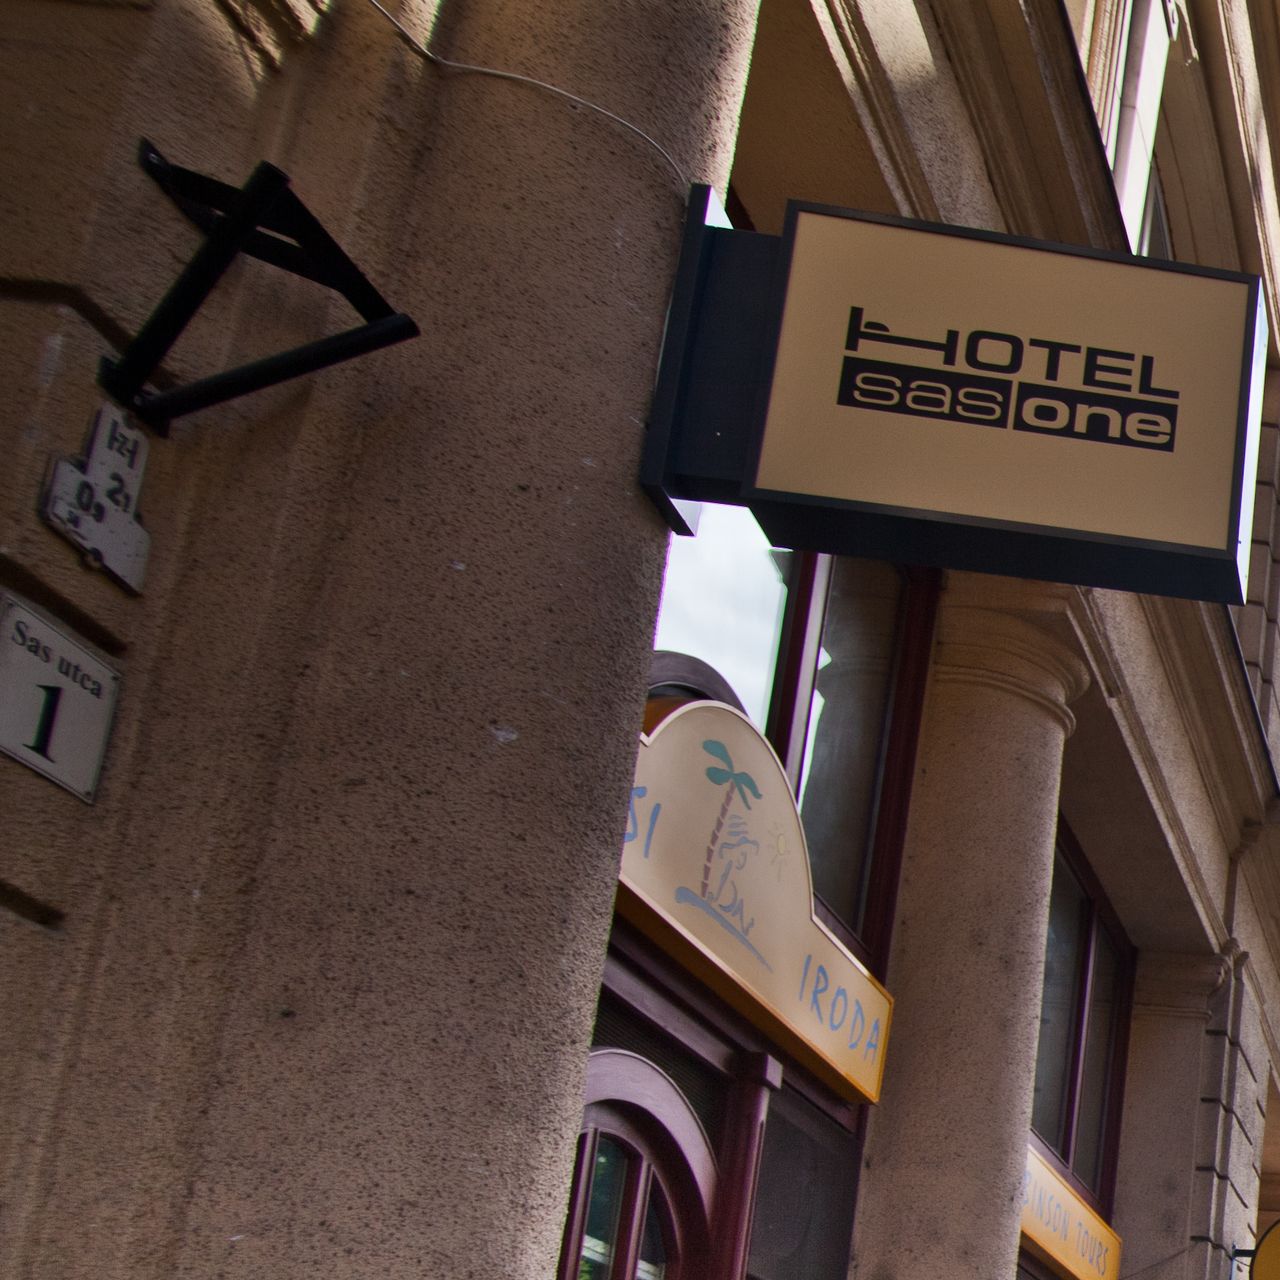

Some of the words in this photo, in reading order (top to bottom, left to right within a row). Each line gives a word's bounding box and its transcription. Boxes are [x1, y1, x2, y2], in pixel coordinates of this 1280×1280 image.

[844, 305, 1181, 400] HOTEL
[11, 619, 51, 664] Sas
[57, 655, 104, 701] utca
[22, 683, 64, 764] 1
[798, 953, 881, 1067] IRODA
[1074, 1220, 1109, 1277] TOURS
